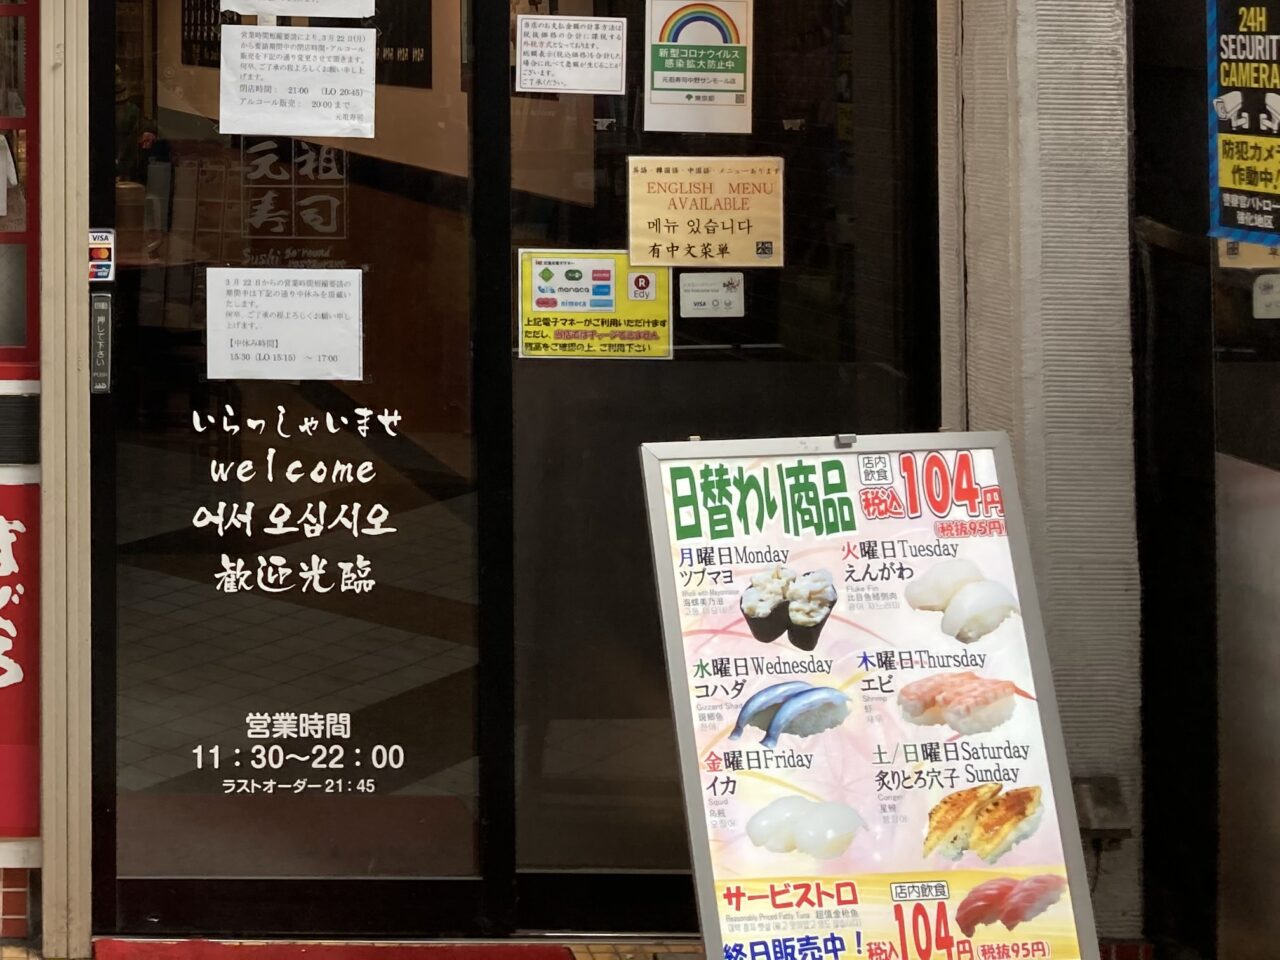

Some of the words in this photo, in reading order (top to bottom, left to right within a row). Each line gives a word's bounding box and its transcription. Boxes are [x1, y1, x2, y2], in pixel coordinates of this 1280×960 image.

[1238, 6, 1268, 32] 24H
[658, 48, 741, 60] 新型コロナウイルス
[664, 58, 736, 71] 感染拡大防止中
[646, 181, 714, 195] ENGLISH
[728, 181, 775, 196] MENU
[667, 196, 751, 212] AVAILABLE
[647, 217, 680, 235] 메뉴
[686, 217, 754, 236] 있습니다
[92, 234, 109, 242] VISA
[557, 286, 590, 294] manaca
[633, 290, 651, 300] Edy
[192, 404, 402, 438] いらっしゃいませ
[209, 447, 377, 483] welcome
[861, 455, 887, 470] 店内
[863, 468, 889, 482] 飲食
[669, 459, 857, 541] 日替わり商品
[192, 500, 255, 537] 어서
[262, 500, 398, 539] 오십시오
[844, 562, 914, 583] えんがわ
[694, 679, 748, 701] コハダ
[860, 674, 895, 694] エビ
[245, 711, 352, 739] 営業時間
[874, 767, 961, 792] 炙りとろ穴子
[965, 762, 1020, 784] Sunday
[706, 775, 737, 797] イカ
[723, 881, 859, 912] サービストロ
[894, 883, 947, 899] 店内飲食
